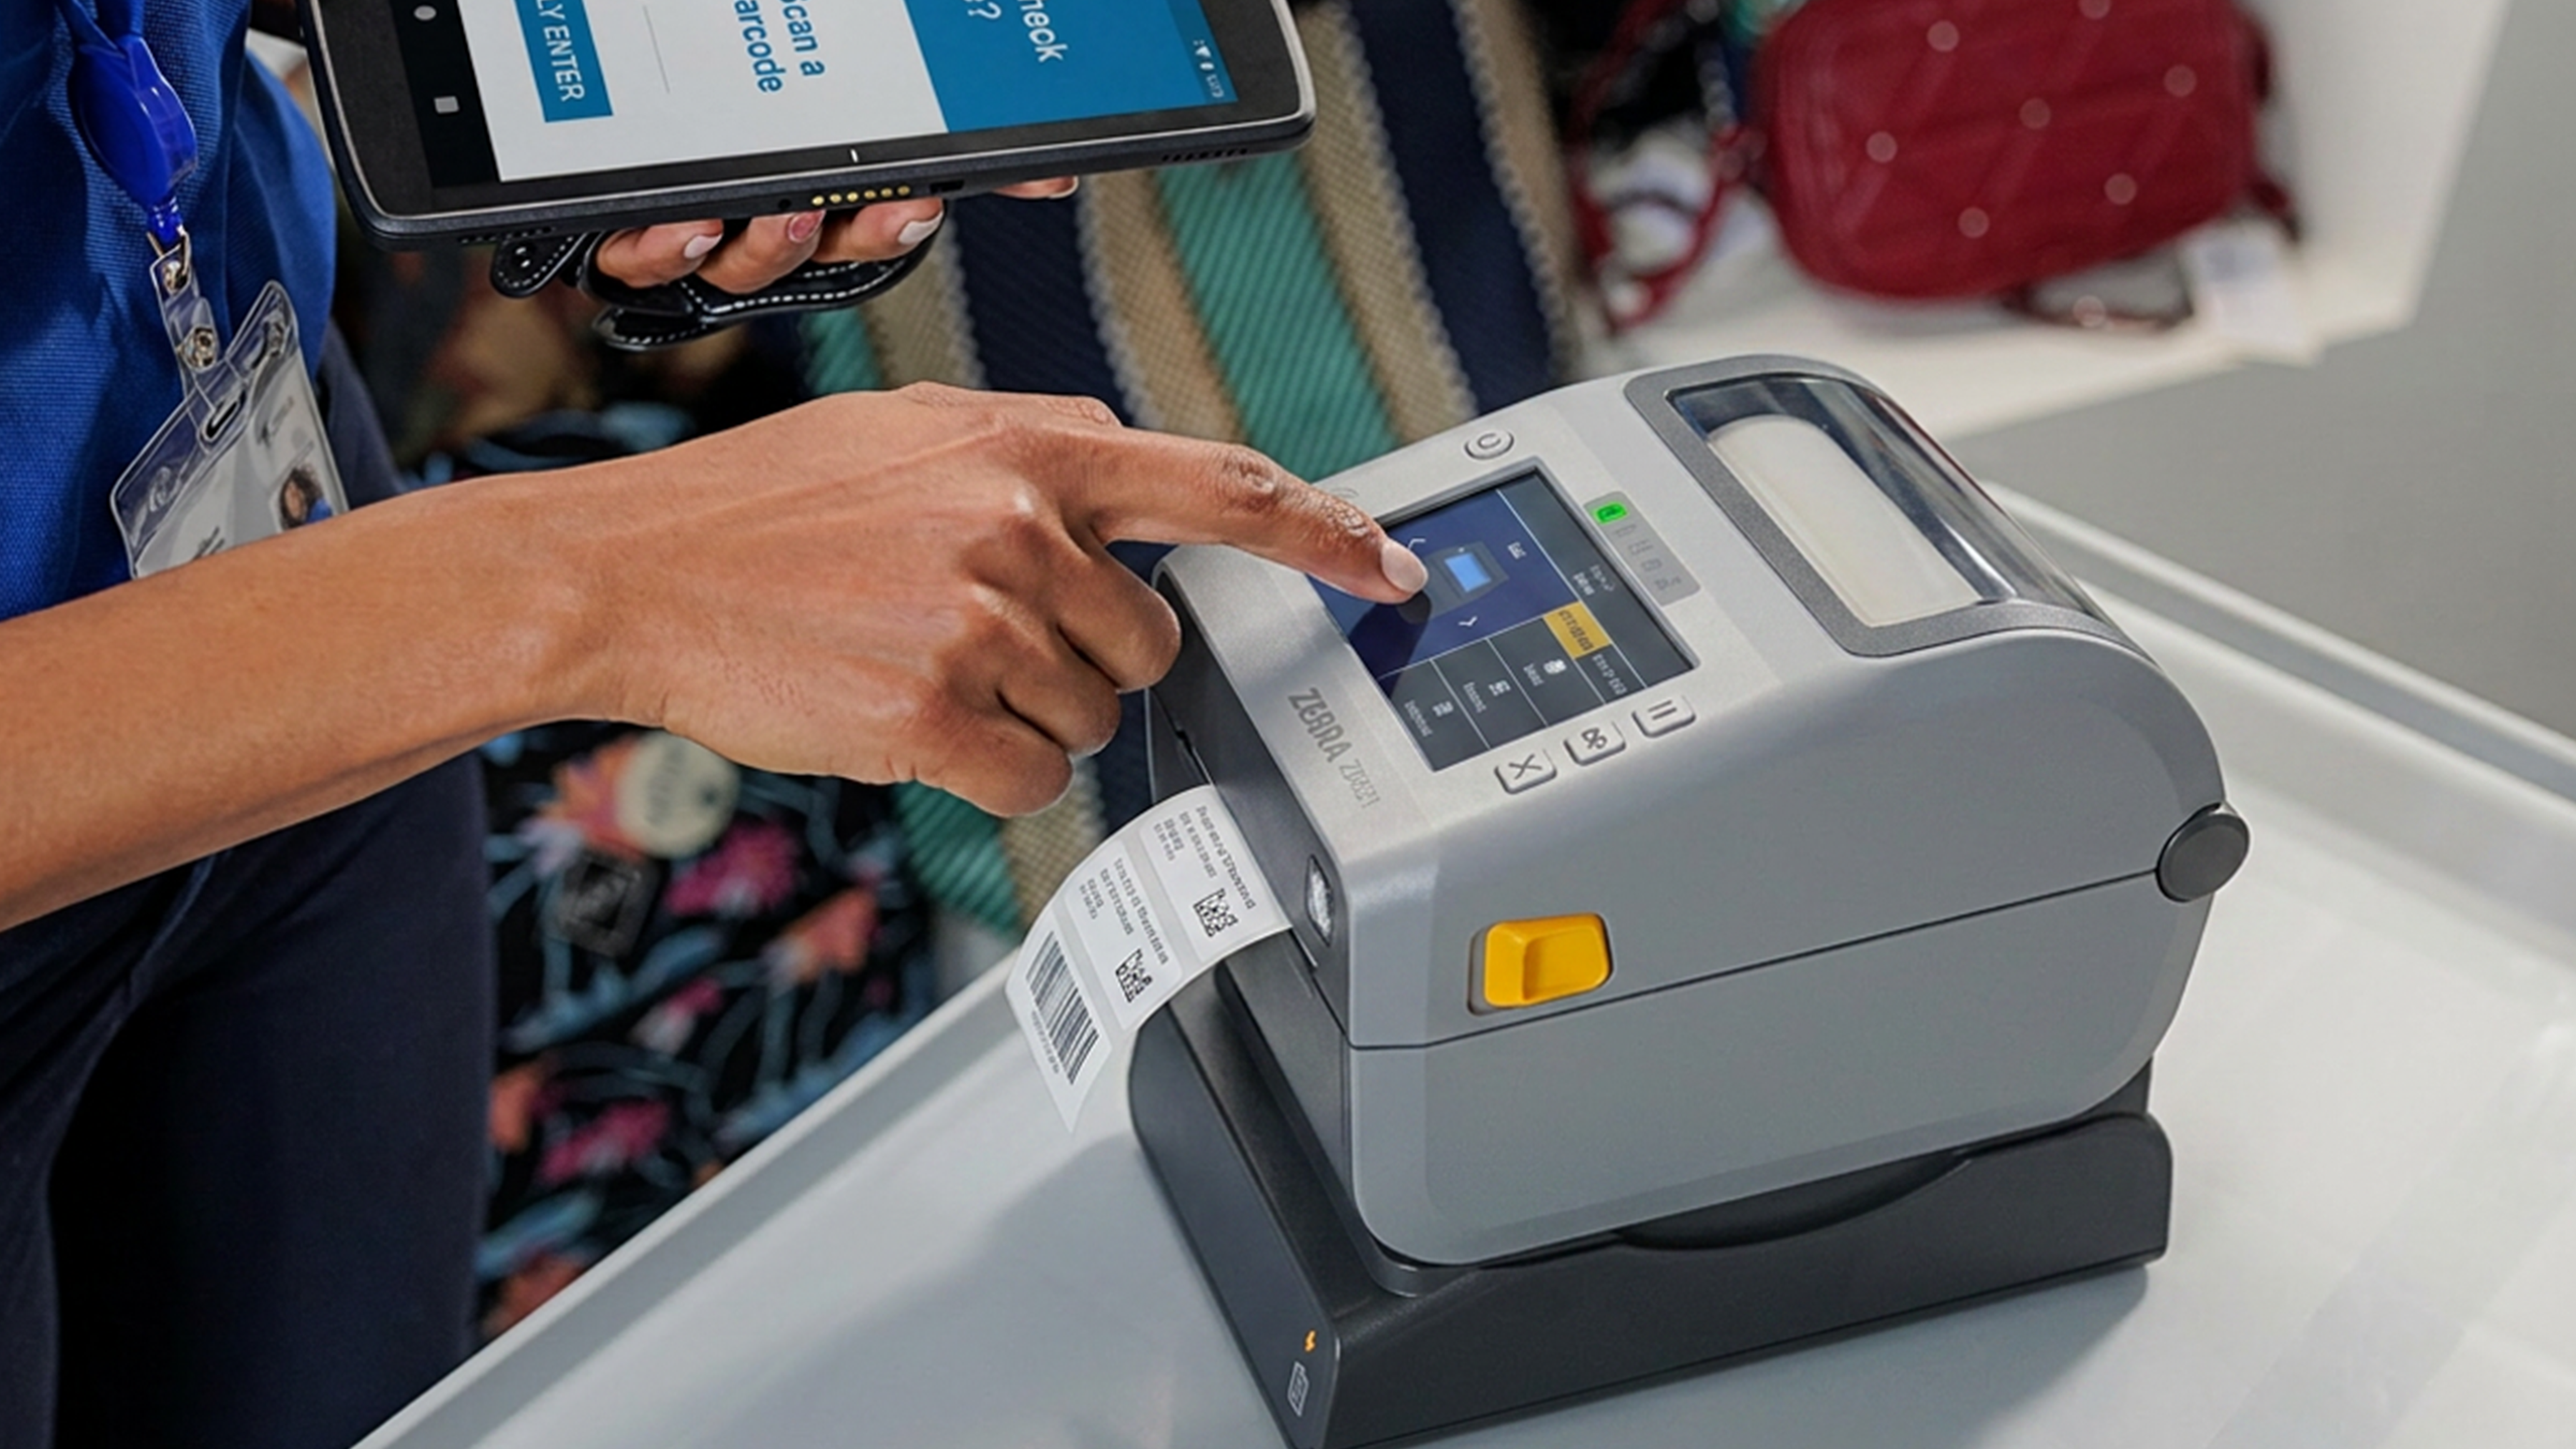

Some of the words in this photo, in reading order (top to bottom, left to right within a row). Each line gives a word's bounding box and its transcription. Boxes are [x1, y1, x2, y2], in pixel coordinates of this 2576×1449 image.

[543, 25, 585, 102] ENTER
[779, 0, 818, 52] can
[799, 60, 825, 76] a
